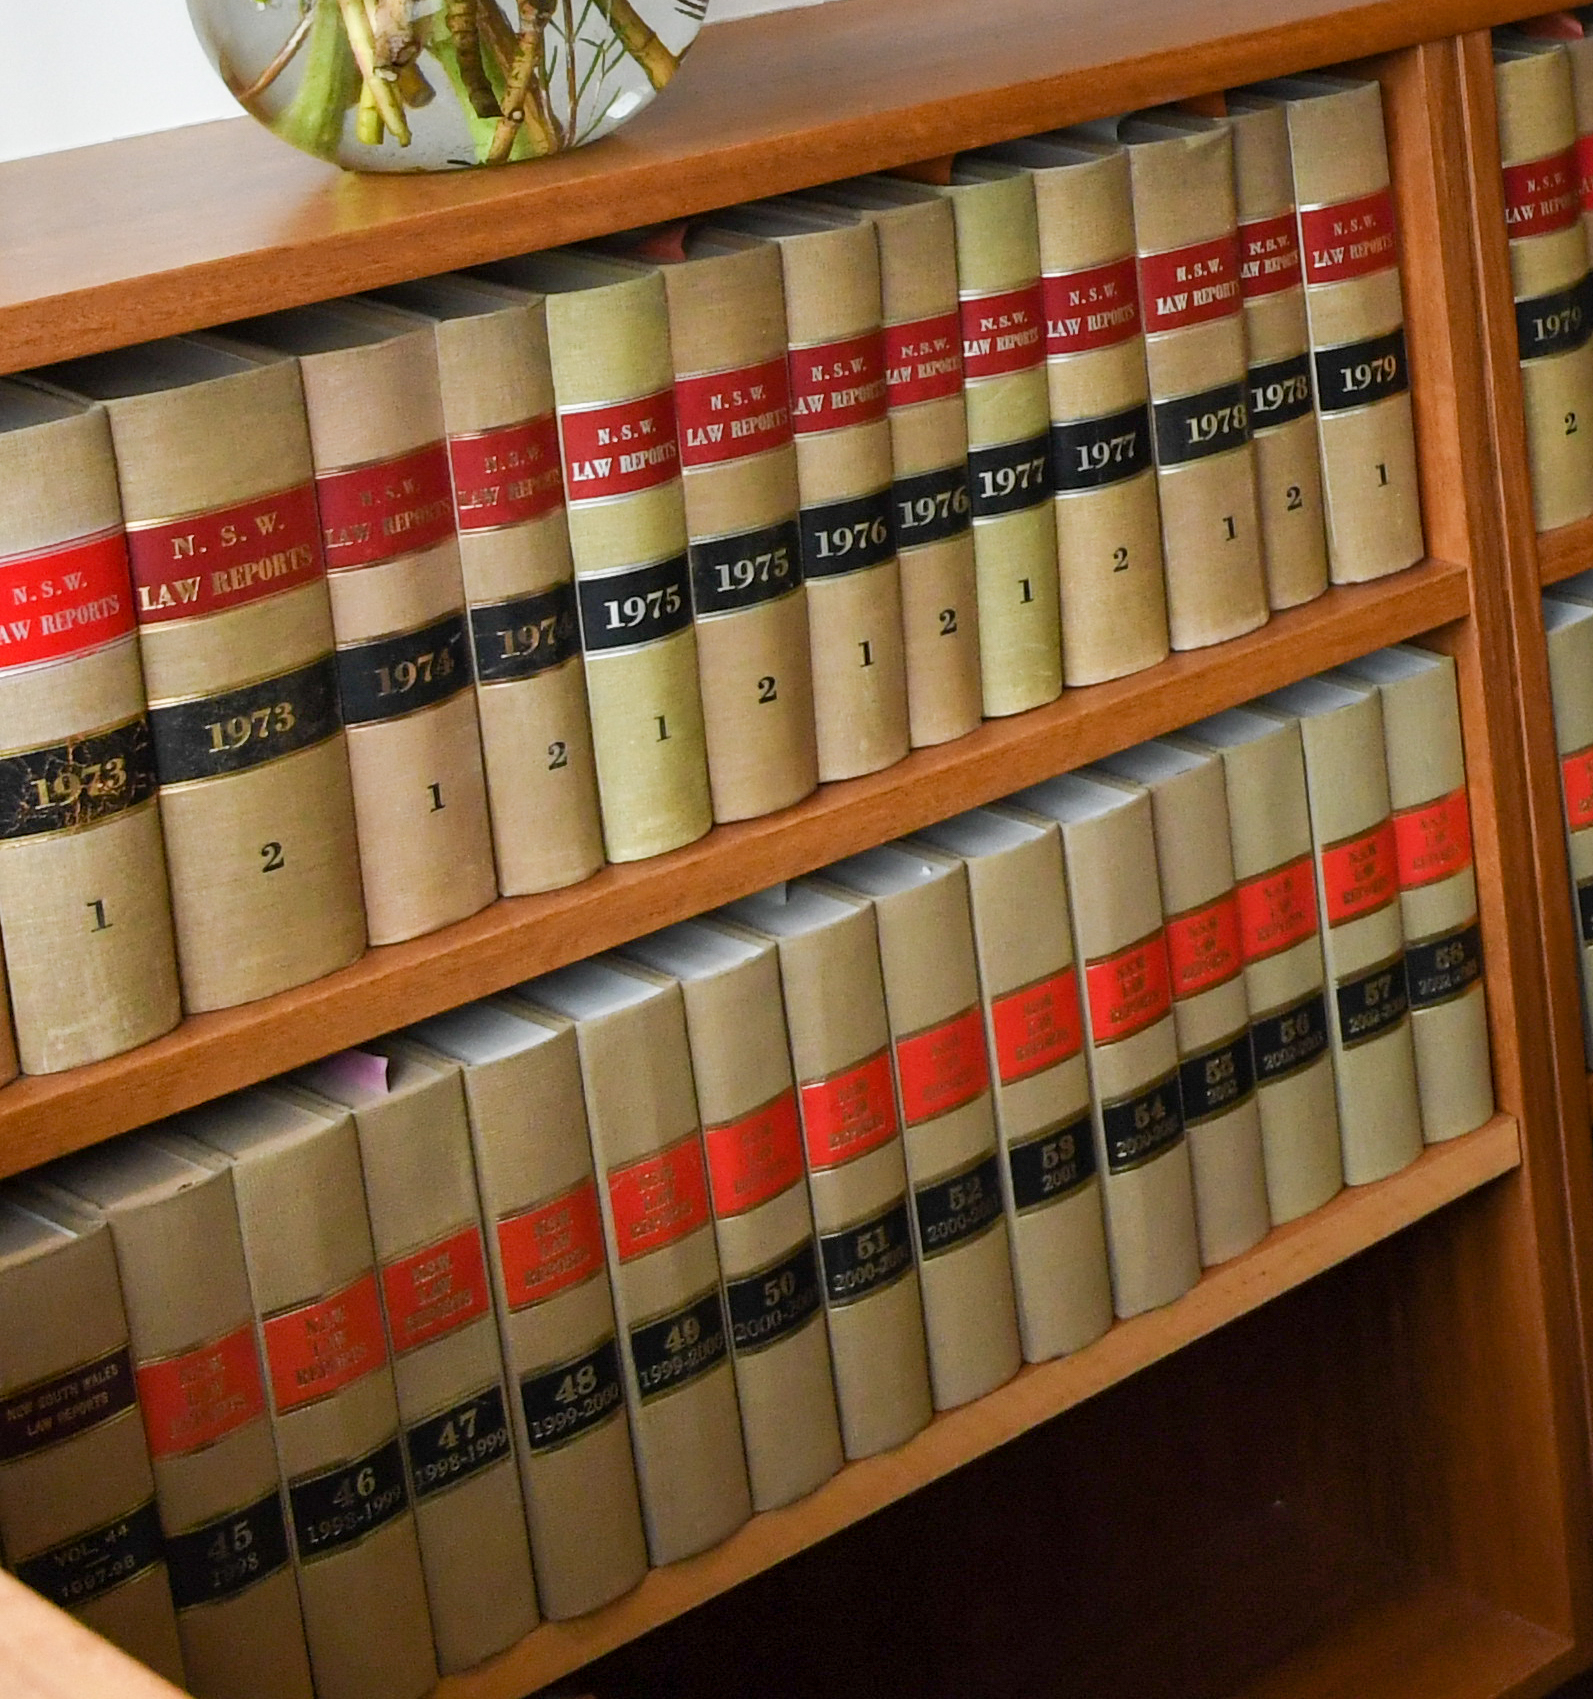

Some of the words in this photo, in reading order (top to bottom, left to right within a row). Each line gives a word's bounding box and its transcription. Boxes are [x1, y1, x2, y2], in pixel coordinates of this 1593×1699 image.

[1504, 202, 1536, 224] LAW
[1312, 247, 1345, 268] LAW
[1047, 318, 1083, 338] LAW
[1088, 303, 1135, 331] REPORTS
[1155, 296, 1188, 316] LAW
[1532, 304, 1582, 343] 1979
[963, 338, 991, 358] LAW
[885, 366, 911, 386] LAW
[1339, 354, 1397, 393] 1979
[1251, 374, 1309, 413] 1978
[686, 424, 724, 447] LAW
[731, 407, 789, 439] REPORTS
[1186, 402, 1248, 444] 1978
[1564, 412, 1578, 436] 2
[572, 457, 612, 481] LAW
[620, 439, 677, 474] REPORTS
[1076, 432, 1137, 472] 1977
[978, 457, 1046, 499] 1977
[1376, 463, 1388, 486] 1
[899, 484, 970, 529] 1976
[1286, 486, 1303, 511] 2
[325, 522, 372, 549] LAW
[814, 516, 888, 559] 1976
[1221, 516, 1236, 541] 1
[138, 576, 201, 611] LAW
[211, 544, 313, 596] REPORTS
[714, 548, 790, 593] 1975
[1113, 547, 1129, 573] 2
[604, 584, 681, 629] 1975
[1017, 578, 1033, 603] 1
[0, 619, 31, 646] AW
[40, 594, 121, 636] REPORTS
[939, 609, 958, 636] 2
[858, 641, 873, 667] 1
[374, 648, 455, 697] 1974
[758, 676, 777, 704] 2
[205, 702, 296, 753] 1973
[654, 715, 669, 741] 1
[548, 741, 568, 771] 2
[30, 757, 128, 810] 1973
[427, 783, 445, 812] 1
[261, 842, 285, 873] 2
[86, 899, 113, 933] 1
[950, 1176, 983, 1211] 52
[856, 1224, 890, 1260] 51
[764, 1270, 795, 1307] 50
[664, 1316, 701, 1352] 49
[554, 1363, 598, 1404] 48
[438, 1407, 478, 1449] 47
[531, 1382, 621, 1438] 1999-2000
[414, 1426, 509, 1486] 1998-1999
[332, 1467, 376, 1507] 46
[208, 1520, 253, 1559] 45
